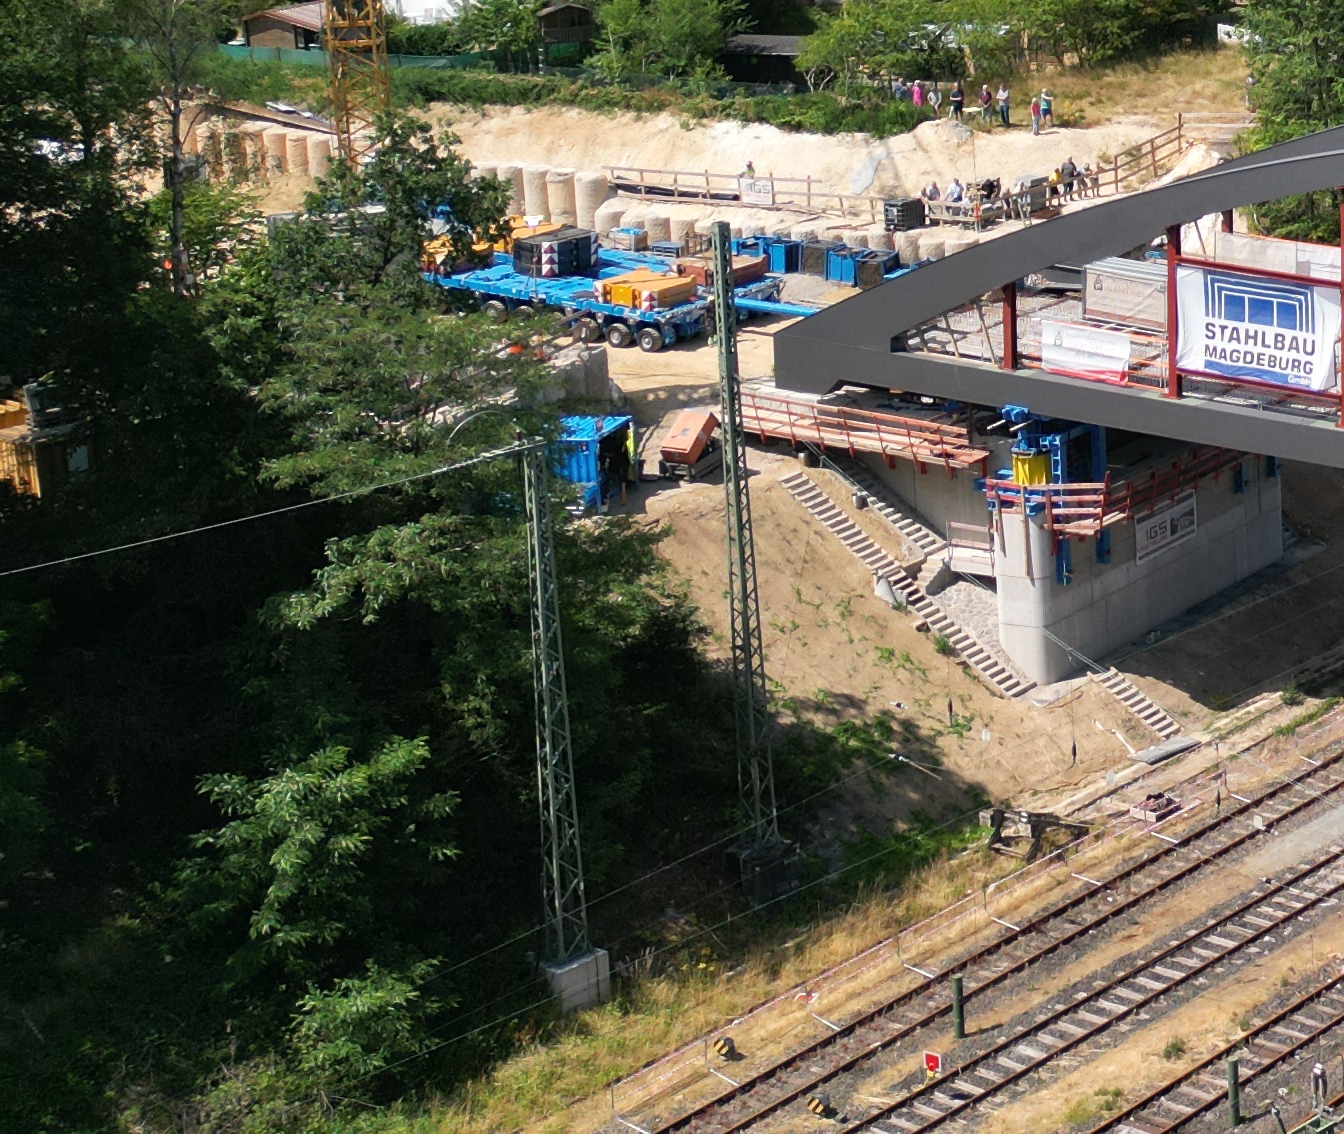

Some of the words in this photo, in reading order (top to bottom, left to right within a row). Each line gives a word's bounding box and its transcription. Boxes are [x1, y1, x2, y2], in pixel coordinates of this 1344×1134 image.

[1205, 322, 1315, 356] STAHLBAU
[1204, 343, 1314, 375] MAGDEBURG
[1287, 374, 1311, 386] GmbH
[1146, 520, 1167, 541] IGS
